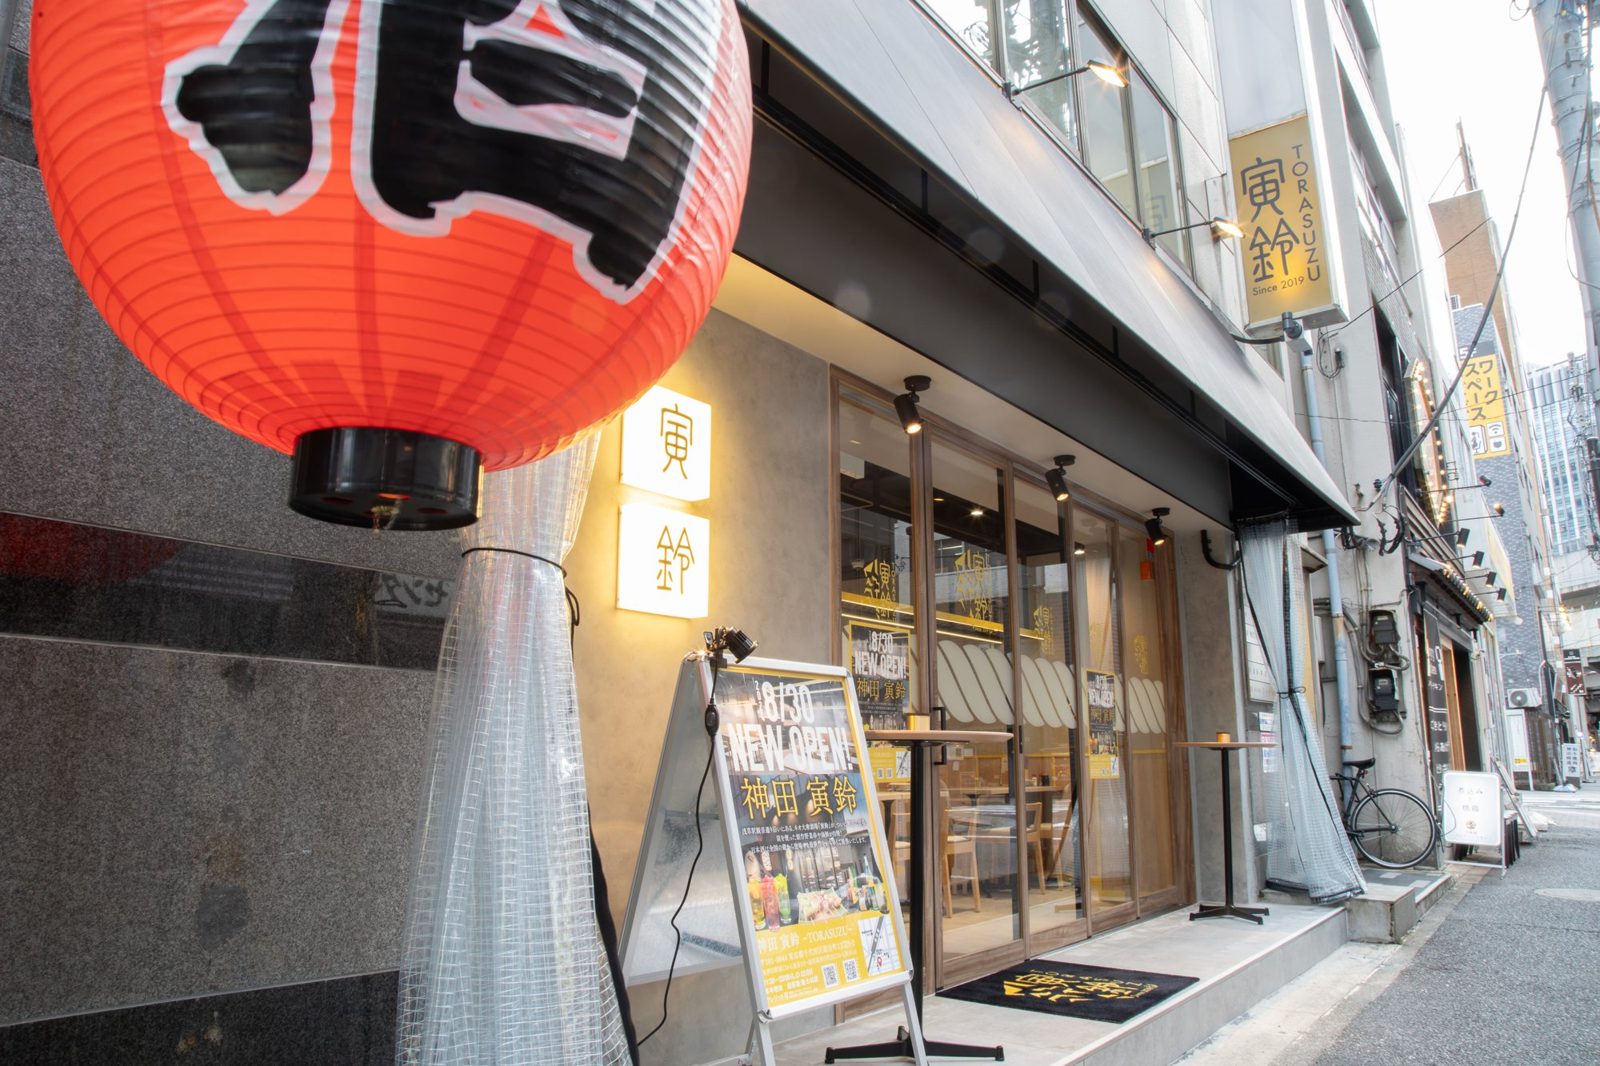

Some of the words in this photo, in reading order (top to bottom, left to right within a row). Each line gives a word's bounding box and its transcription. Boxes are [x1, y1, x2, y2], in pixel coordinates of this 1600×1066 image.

[1240, 156, 1300, 283] 寅鈴
[1291, 144, 1321, 282] TORASUZU
[1252, 284, 1278, 296] Since
[1281, 275, 1305, 290] 2019
[1465, 362, 1487, 421] スペース
[1480, 359, 1499, 405] ワーク
[855, 650, 879, 676] NEW
[880, 654, 907, 679] OPEN!
[871, 631, 894, 654] 8/30
[761, 681, 815, 723] 8/30
[857, 678, 880, 699] 神田
[884, 680, 906, 700] 寅鈴
[727, 723, 785, 772] NEW
[788, 726, 854, 772] OPEN!
[740, 777, 799, 820] 神田
[806, 776, 857, 818] 寅鈴
